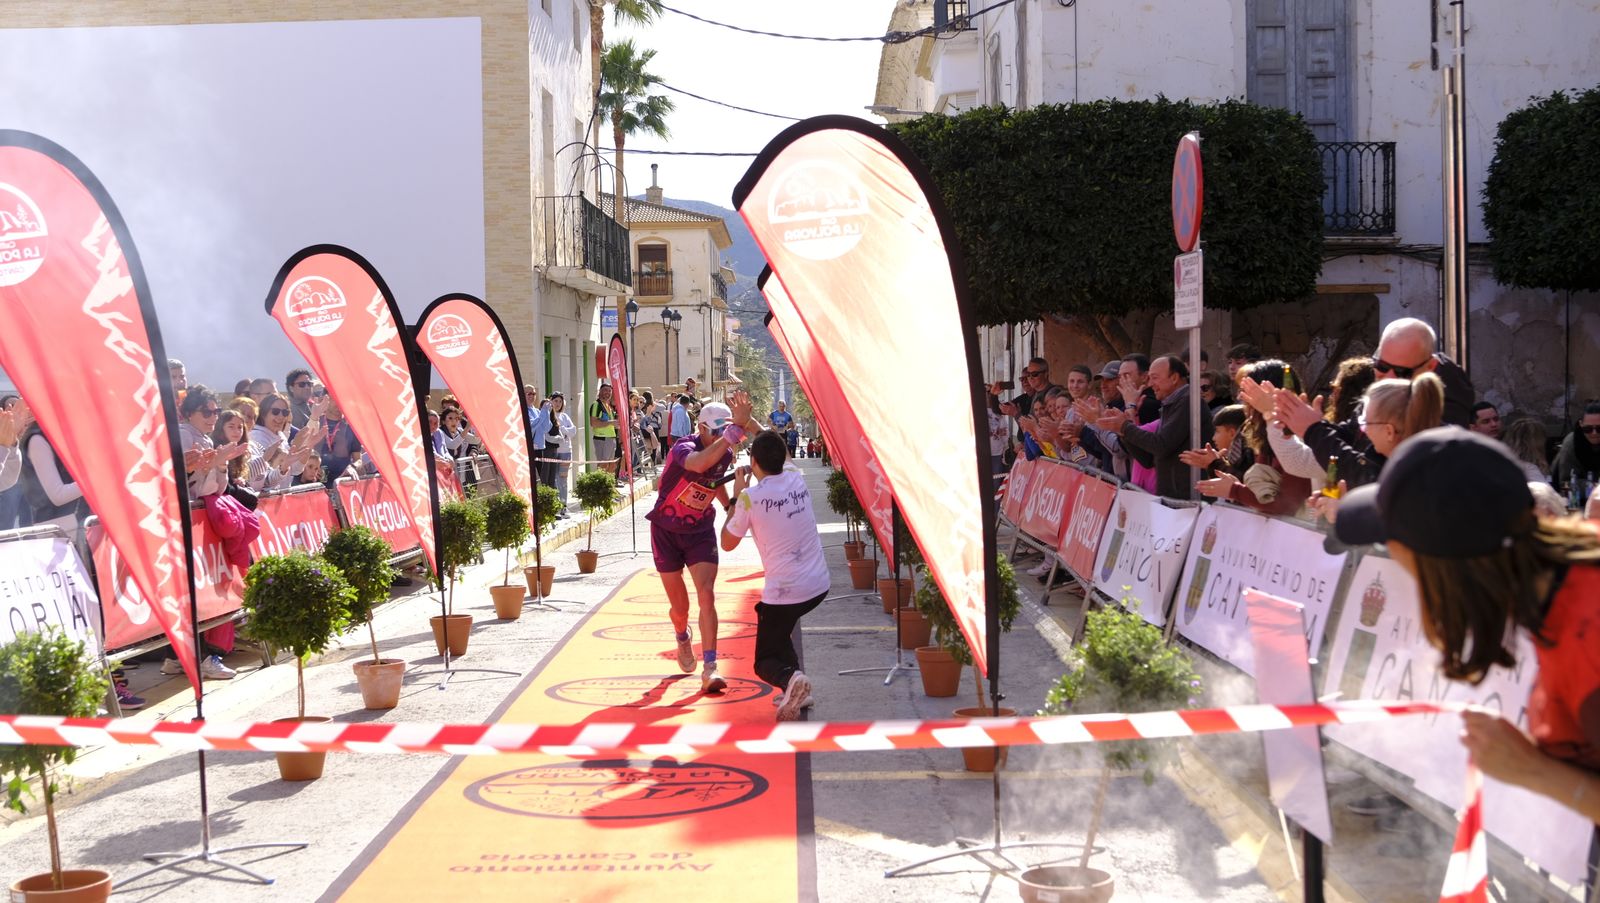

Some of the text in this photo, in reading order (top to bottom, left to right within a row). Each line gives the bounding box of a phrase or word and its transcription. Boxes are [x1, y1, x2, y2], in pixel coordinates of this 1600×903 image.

[692, 490, 707, 501] 38
[761, 498, 790, 513] Pepe
[367, 501, 411, 533] VEOLIA
[278, 518, 330, 557] VEOLIA
[193, 542, 233, 590] OLIA
[51, 569, 76, 589] DE
[1307, 576, 1326, 603] DE
[480, 852, 694, 862] de Cantoria
[448, 862, 714, 874] Ayuntamiento
